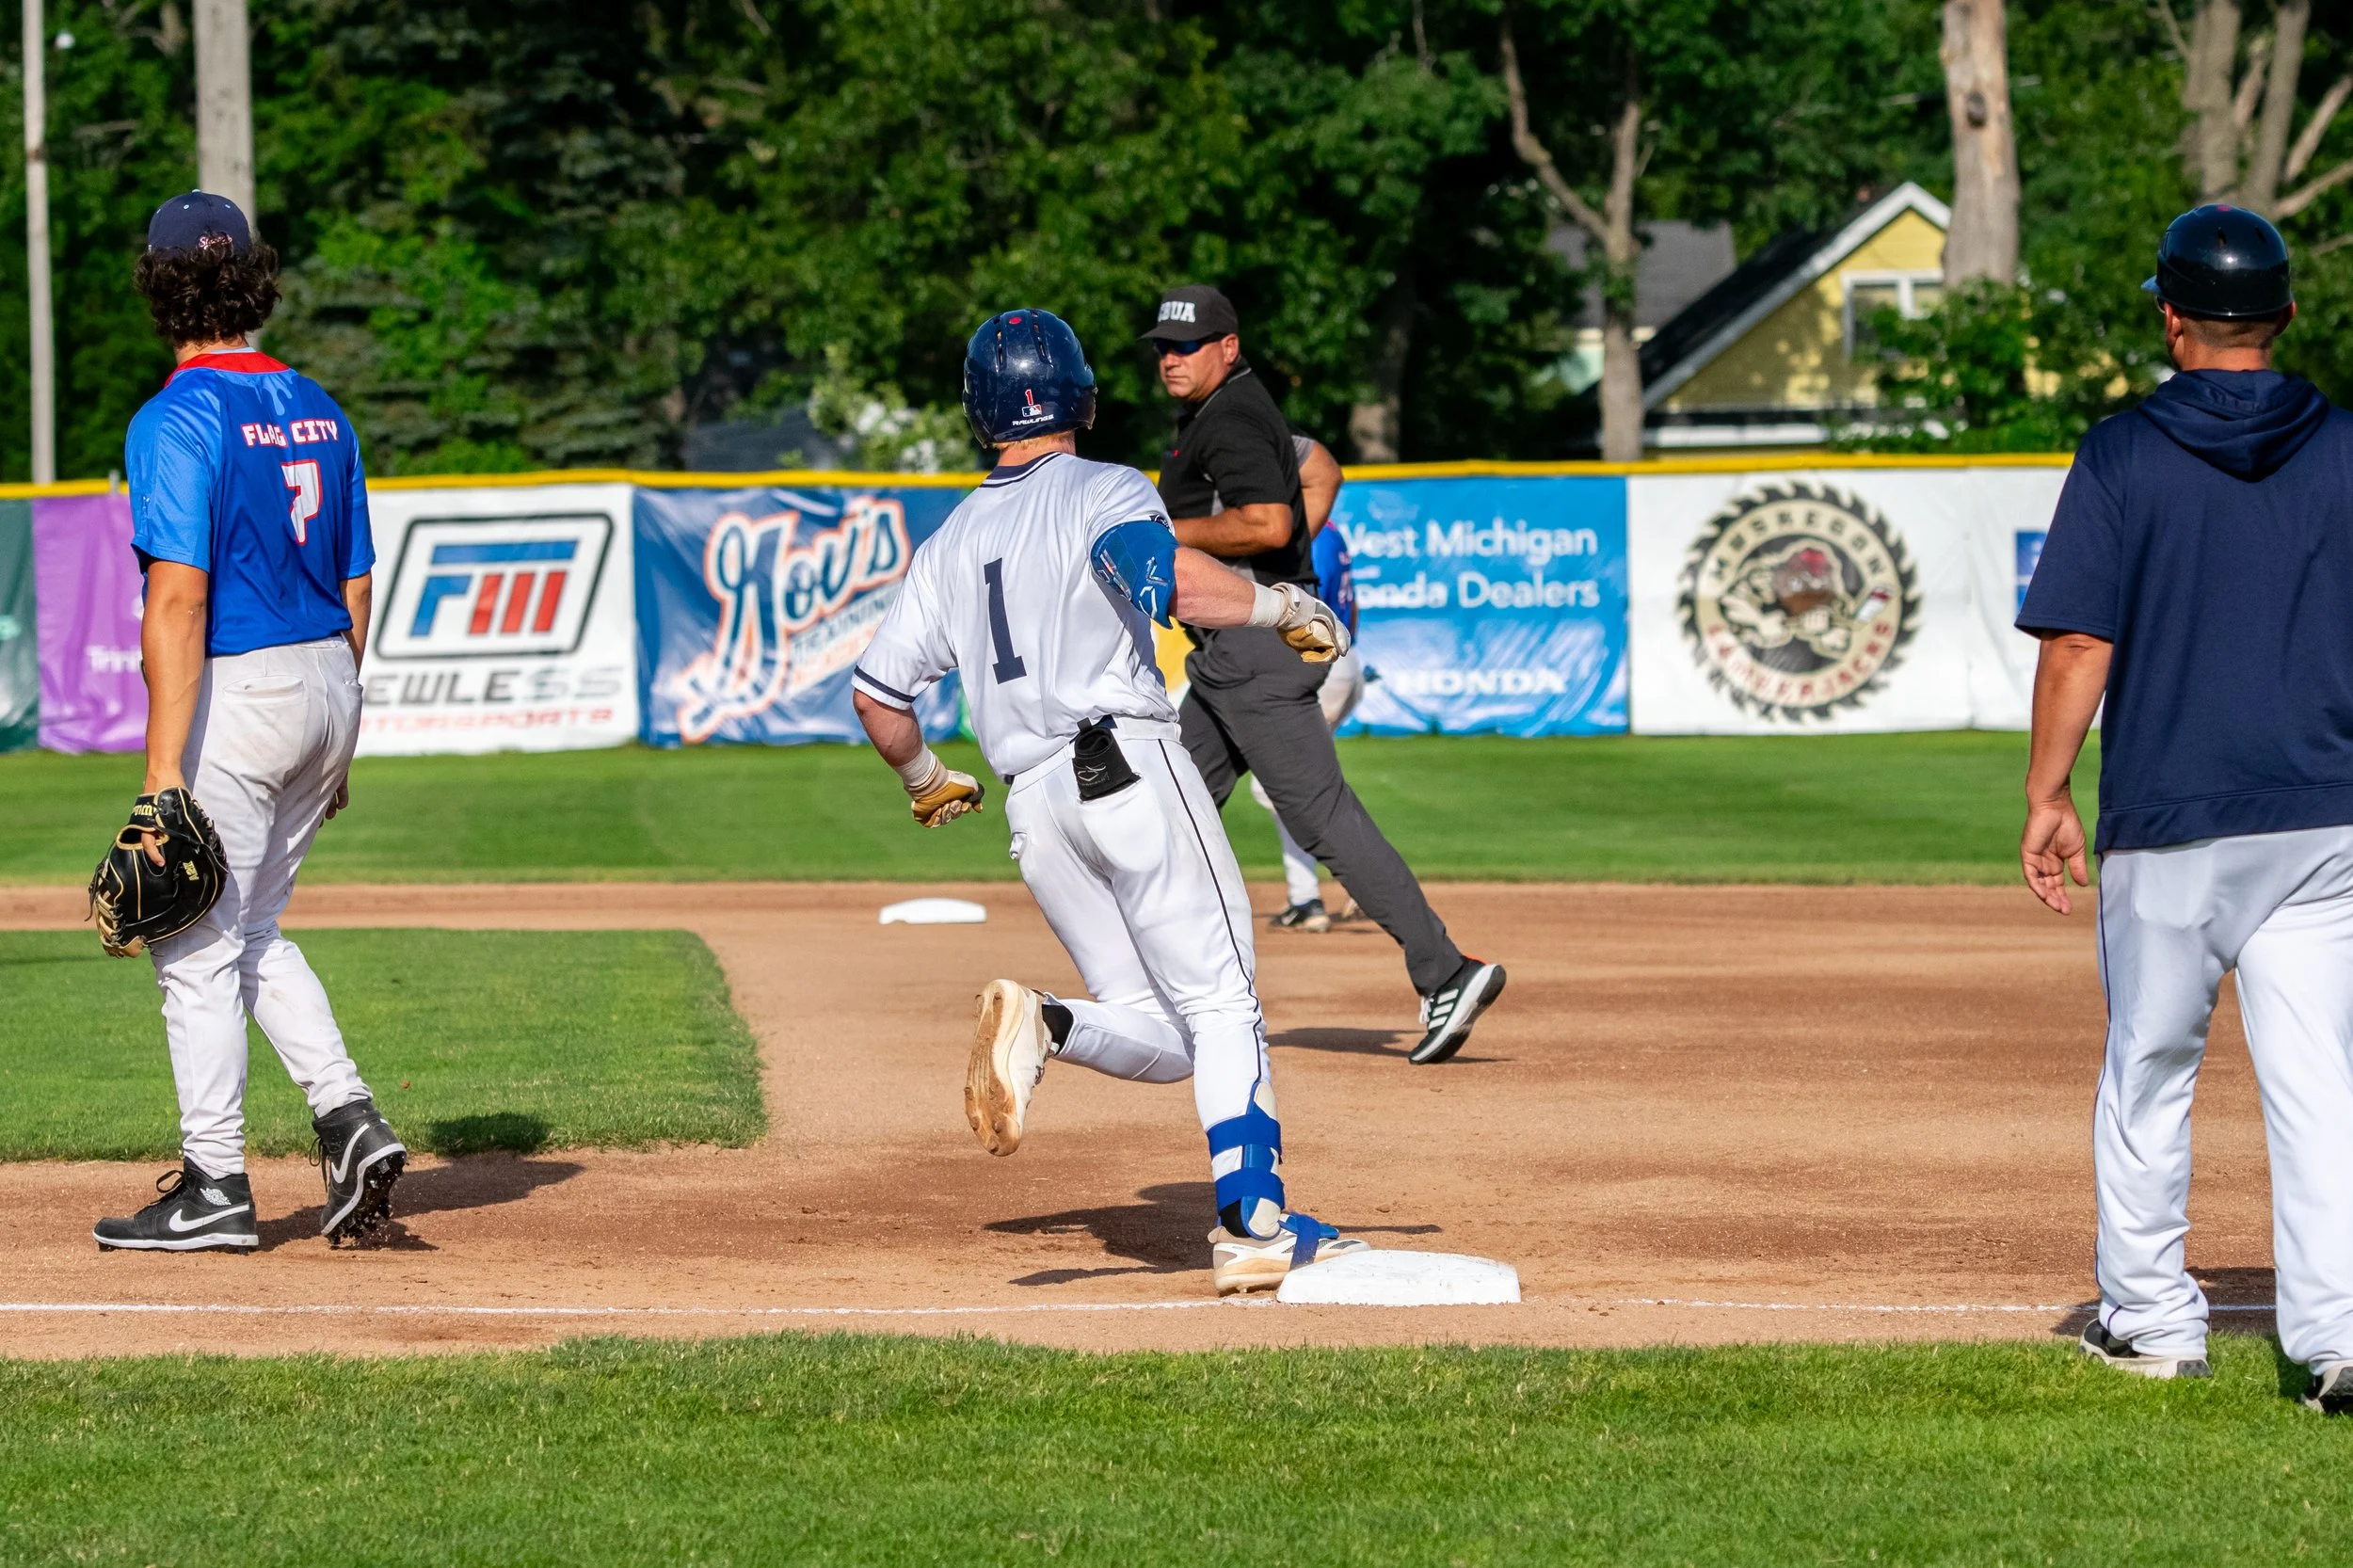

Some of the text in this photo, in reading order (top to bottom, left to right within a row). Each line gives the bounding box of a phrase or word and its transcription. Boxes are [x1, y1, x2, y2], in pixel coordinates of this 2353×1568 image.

[1025, 389, 1033, 406] 1
[241, 418, 338, 448] FLAG CITY
[280, 458, 322, 545] 7
[1427, 517, 1598, 567] Michigan
[1353, 570, 1448, 610] onda
[1459, 568, 1599, 610] Dealers
[984, 557, 1027, 684] 1
[87, 646, 143, 673] Trin
[361, 666, 624, 707] EWLESS
[1395, 666, 1567, 695] HONDA
